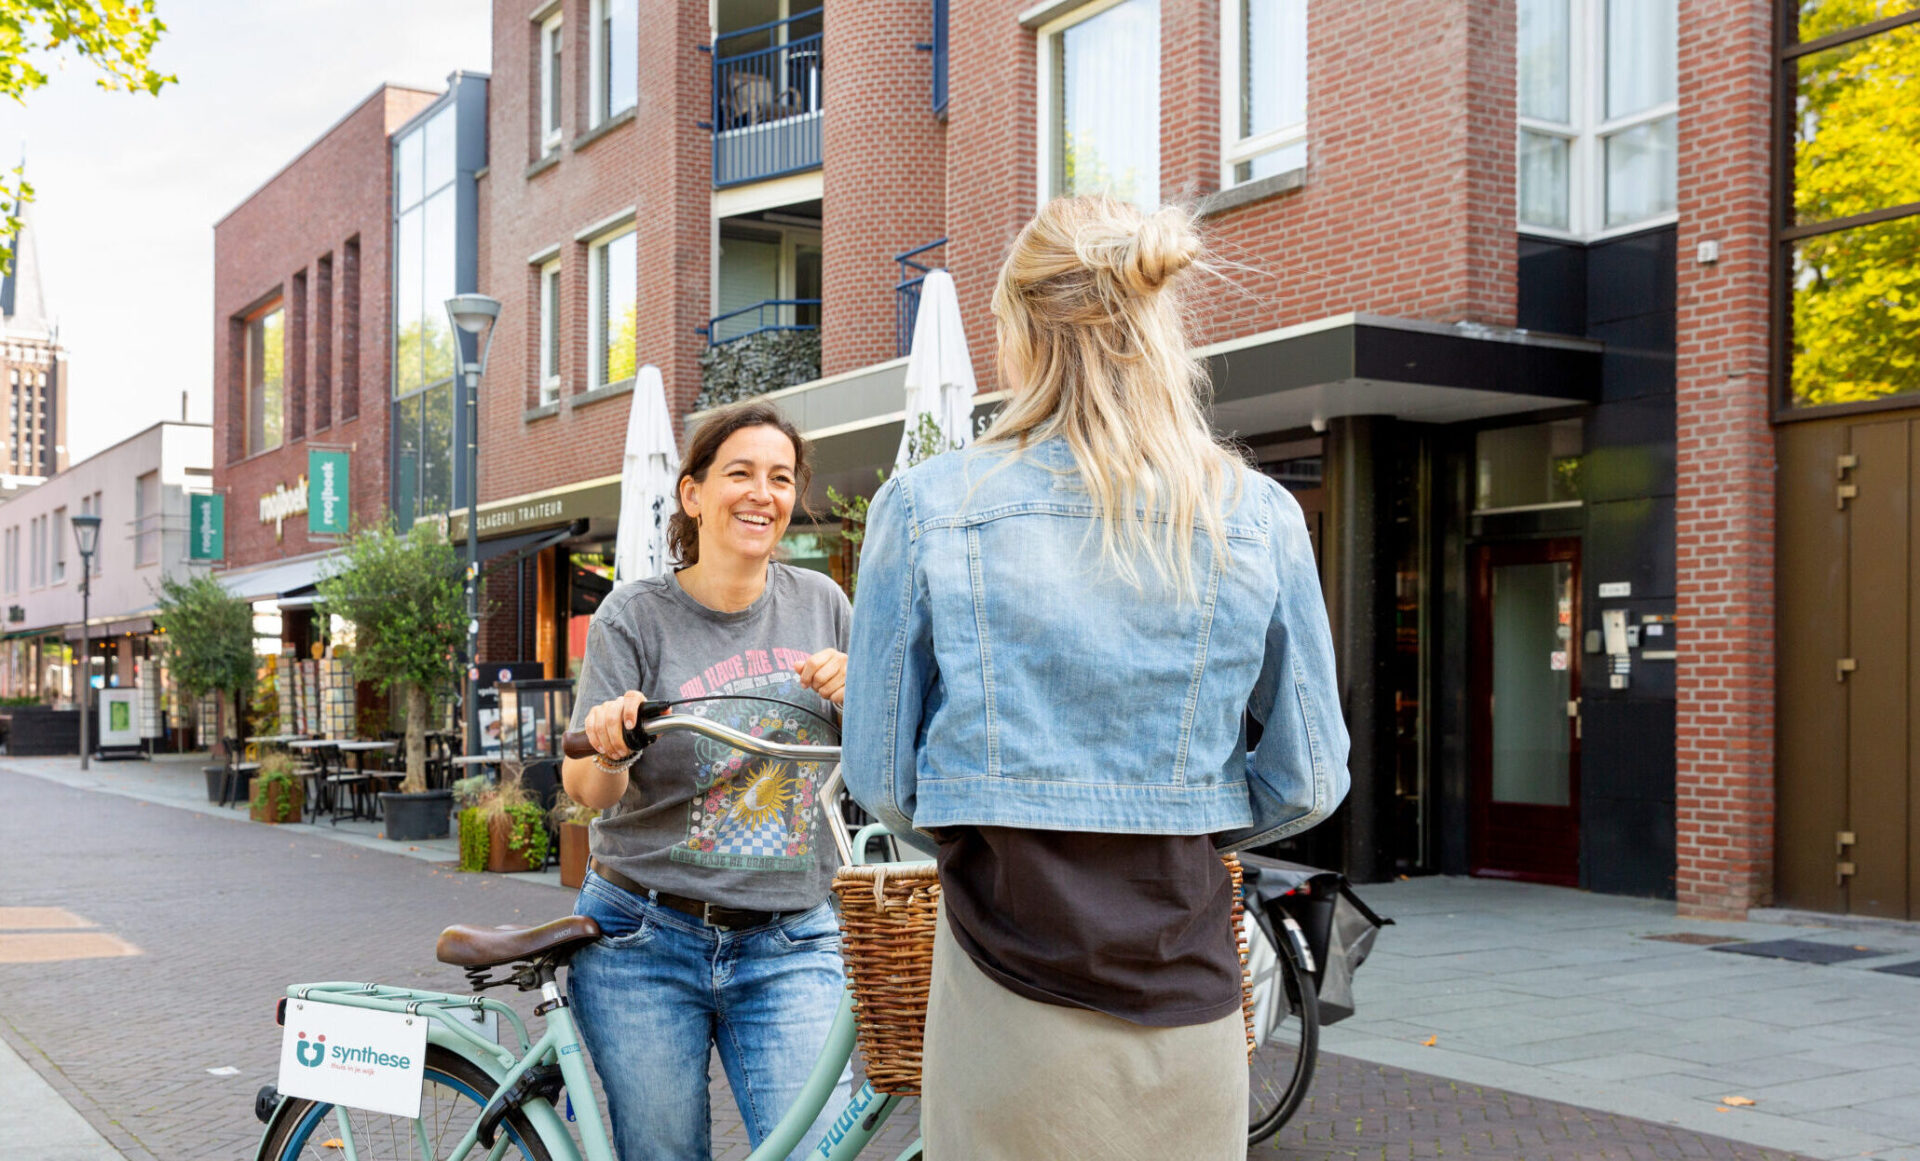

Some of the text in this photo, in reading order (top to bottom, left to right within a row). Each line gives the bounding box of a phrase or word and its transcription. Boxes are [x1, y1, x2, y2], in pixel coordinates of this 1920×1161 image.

[519, 501, 562, 521] TRAITEUR
[704, 654, 745, 691] HAVE
[745, 649, 773, 676] THE
[332, 1045, 410, 1069] synthese
